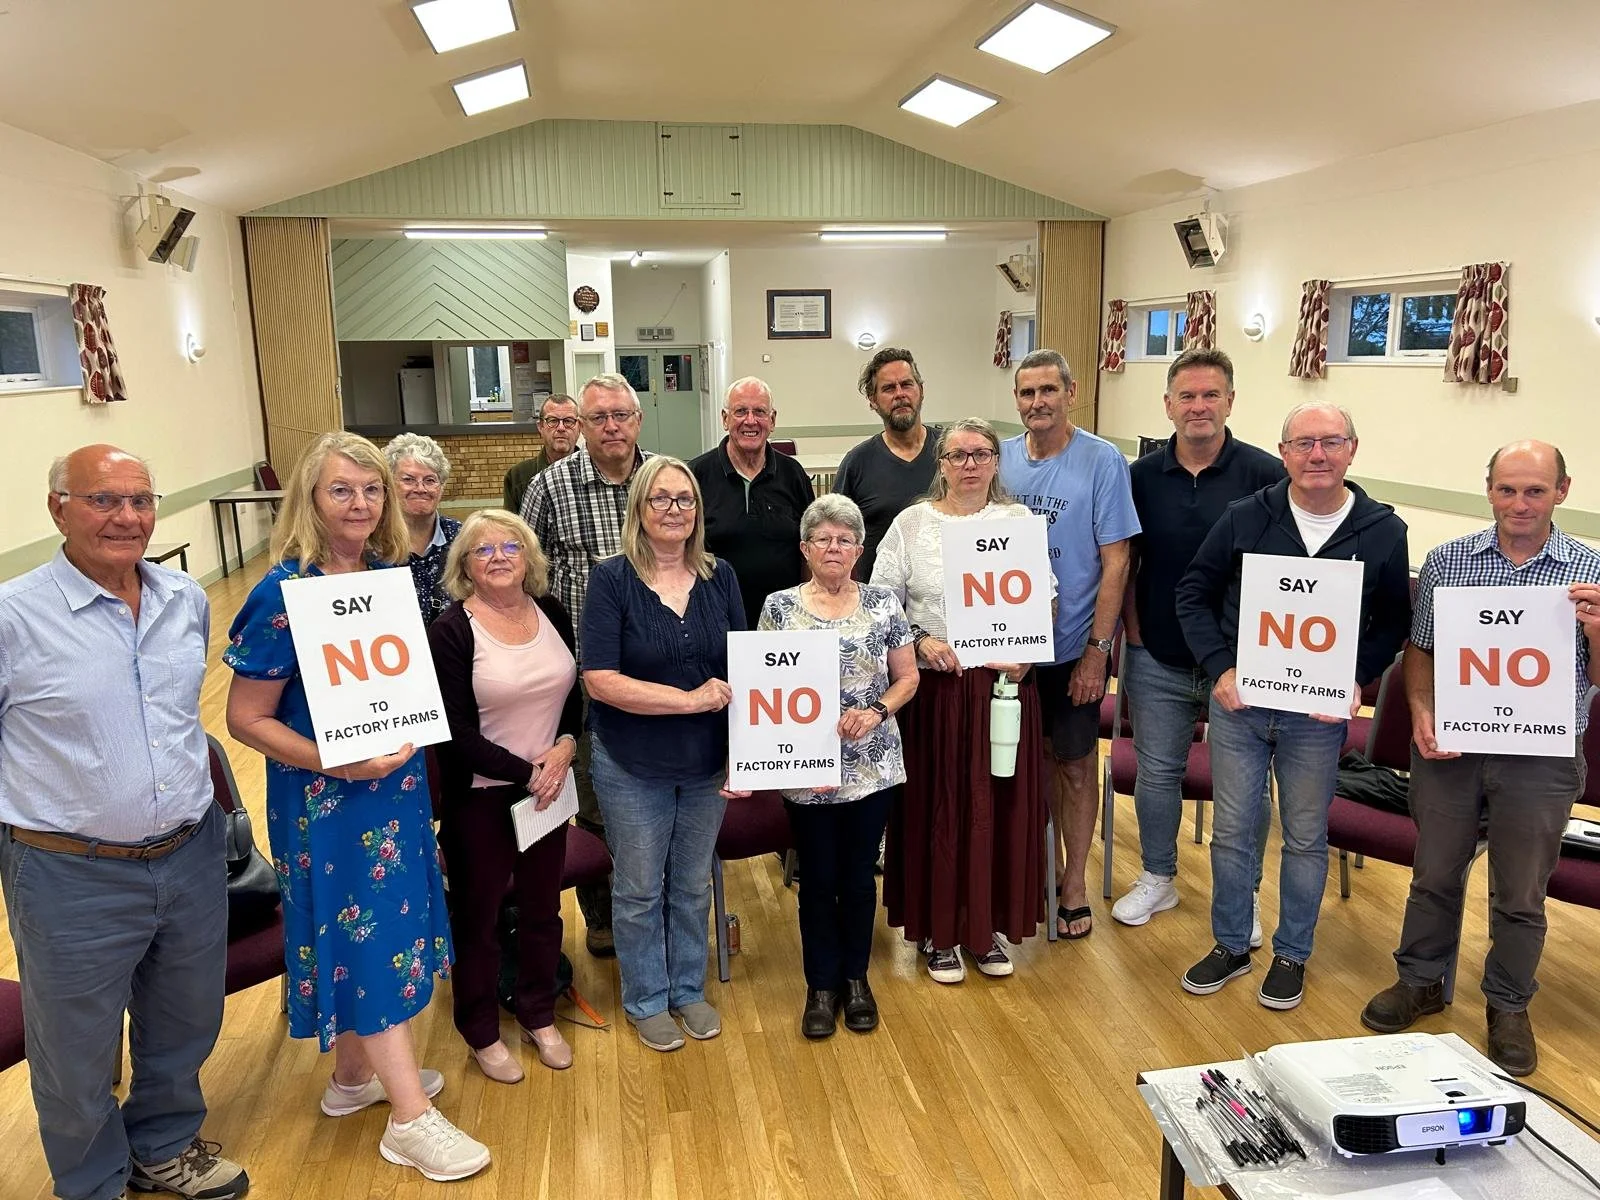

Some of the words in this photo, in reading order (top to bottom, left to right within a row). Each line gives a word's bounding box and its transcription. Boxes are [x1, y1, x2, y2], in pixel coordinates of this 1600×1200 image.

[1033, 494, 1044, 506] IN
[1046, 495, 1069, 511] THE
[975, 536, 1010, 553] SAY
[962, 569, 1032, 608] NO
[1278, 577, 1319, 594] SAY
[331, 594, 373, 616] SAY
[1478, 609, 1525, 625] SAY
[992, 623, 1007, 633] TO
[1258, 611, 1337, 653] NO
[954, 637, 1006, 649] FACTORY
[1007, 634, 1047, 646] FARMS
[322, 634, 410, 687] NO
[764, 651, 801, 667] SAY
[1285, 667, 1303, 678] TO
[1459, 647, 1551, 688] NO
[1242, 677, 1299, 693] FACTORY
[1301, 684, 1346, 699] FARMS
[369, 700, 389, 714] TO
[749, 686, 822, 726] NO
[1493, 706, 1514, 717] TO
[324, 718, 390, 743] FACTORY
[392, 709, 439, 729] FARMS
[1443, 721, 1511, 733] FACTORY
[1513, 723, 1567, 736] FARMS
[777, 743, 794, 754] TO
[736, 760, 791, 772] FACTORY
[793, 758, 835, 770] FARMS
[1421, 1124, 1445, 1134] EPSON
